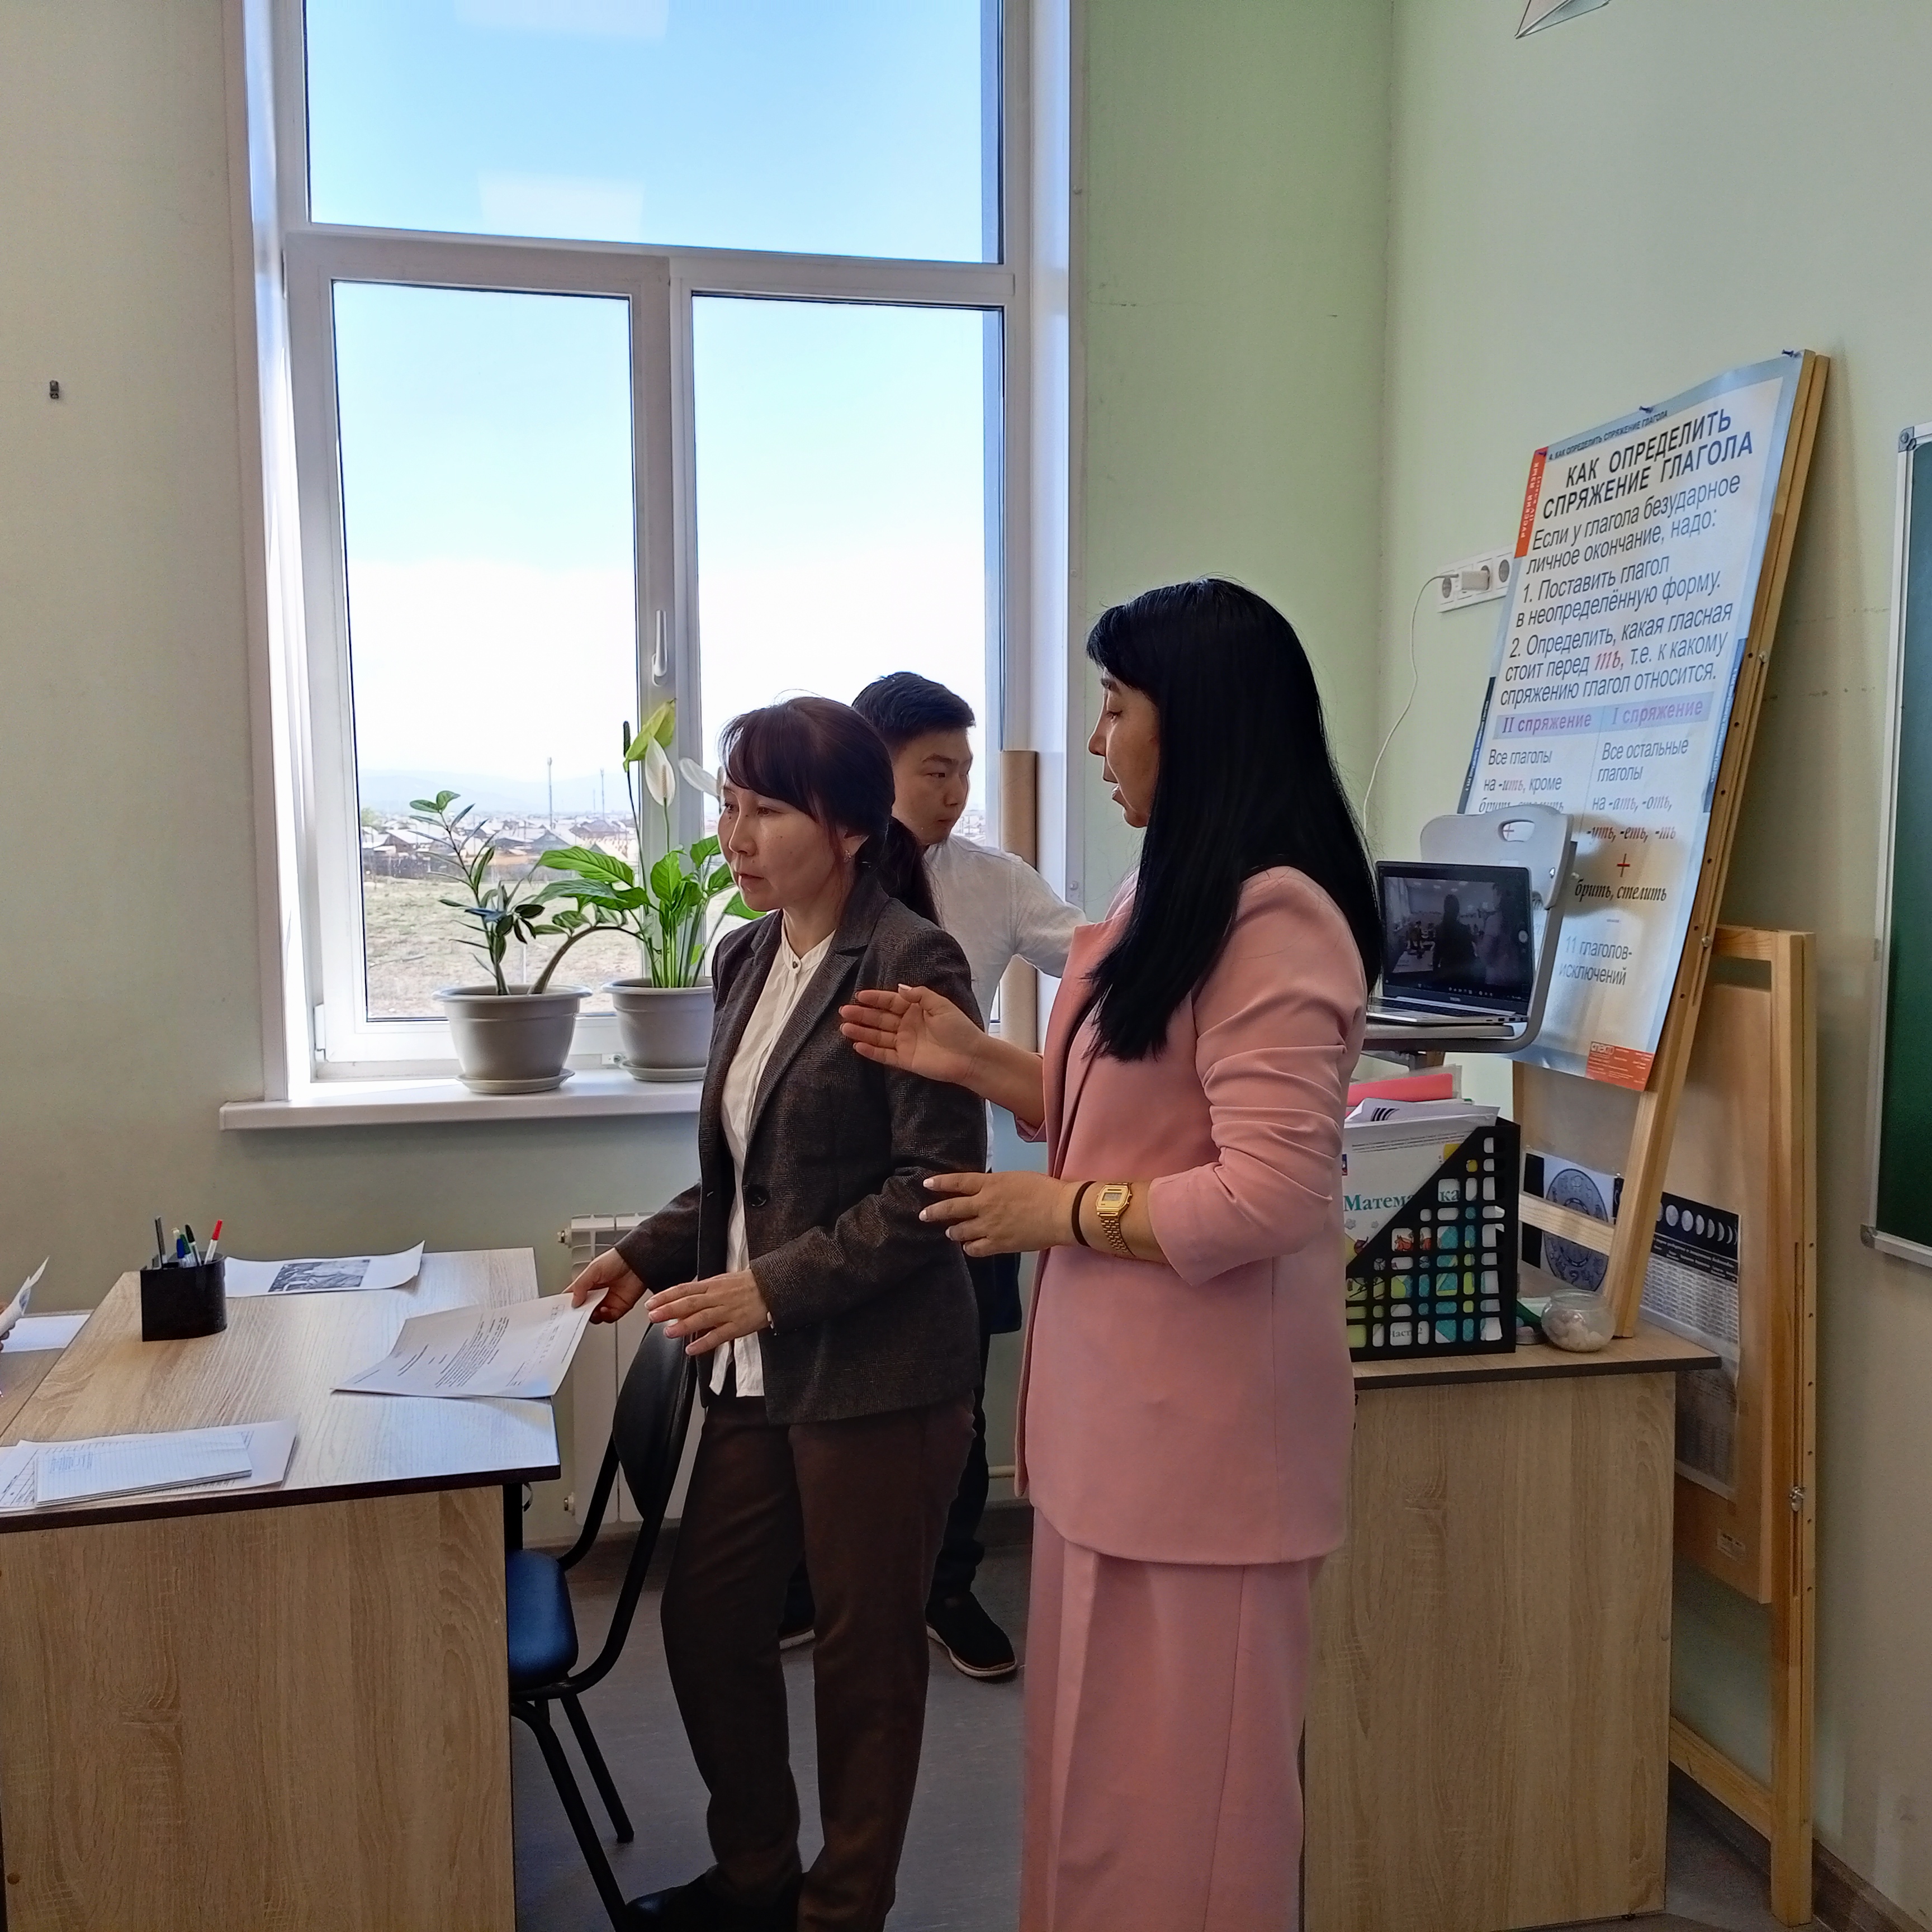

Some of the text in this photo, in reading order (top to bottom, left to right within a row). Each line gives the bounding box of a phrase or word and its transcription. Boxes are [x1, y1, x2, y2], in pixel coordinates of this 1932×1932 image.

[1603, 421, 1640, 441] СПРЯЖЕНИЕ
[1641, 410, 1667, 428] ГЛАГОЛА
[1566, 409, 1731, 488] КАК ОПРЕДЕЛИТЬ
[1543, 431, 1753, 519] СПРЯЖЕНИЕ ГЛАГОЛА
[1532, 475, 1740, 550] Если у глагола безударное
[1526, 509, 1717, 575] личное окончание, надо:
[1523, 556, 1670, 603] 1. Поставить глагол
[1516, 570, 1721, 627] в неопределённую форму.
[1509, 602, 1733, 659] 2. Определить, какая гласная
[1505, 662, 1543, 682] стоит
[1546, 655, 1590, 681] перед
[1631, 646, 1651, 665] т.е.
[1658, 643, 1667, 661] к
[1670, 631, 1728, 659] какому
[1500, 662, 1716, 709] спряжению глагол относится.
[1502, 714, 1592, 735] II спряжение
[1612, 700, 1703, 726] I спряжение
[1488, 749, 1553, 765] Все глаголы
[1602, 739, 1689, 760] Все остальные
[1483, 779, 1496, 791] на
[1528, 777, 1562, 795] кроме
[1597, 766, 1644, 782] глаголы
[1592, 797, 1606, 811] на
[1575, 878, 1667, 902] брить, стелить
[1565, 935, 1632, 960] 11 глаголов-
[1559, 962, 1627, 986] исключений
